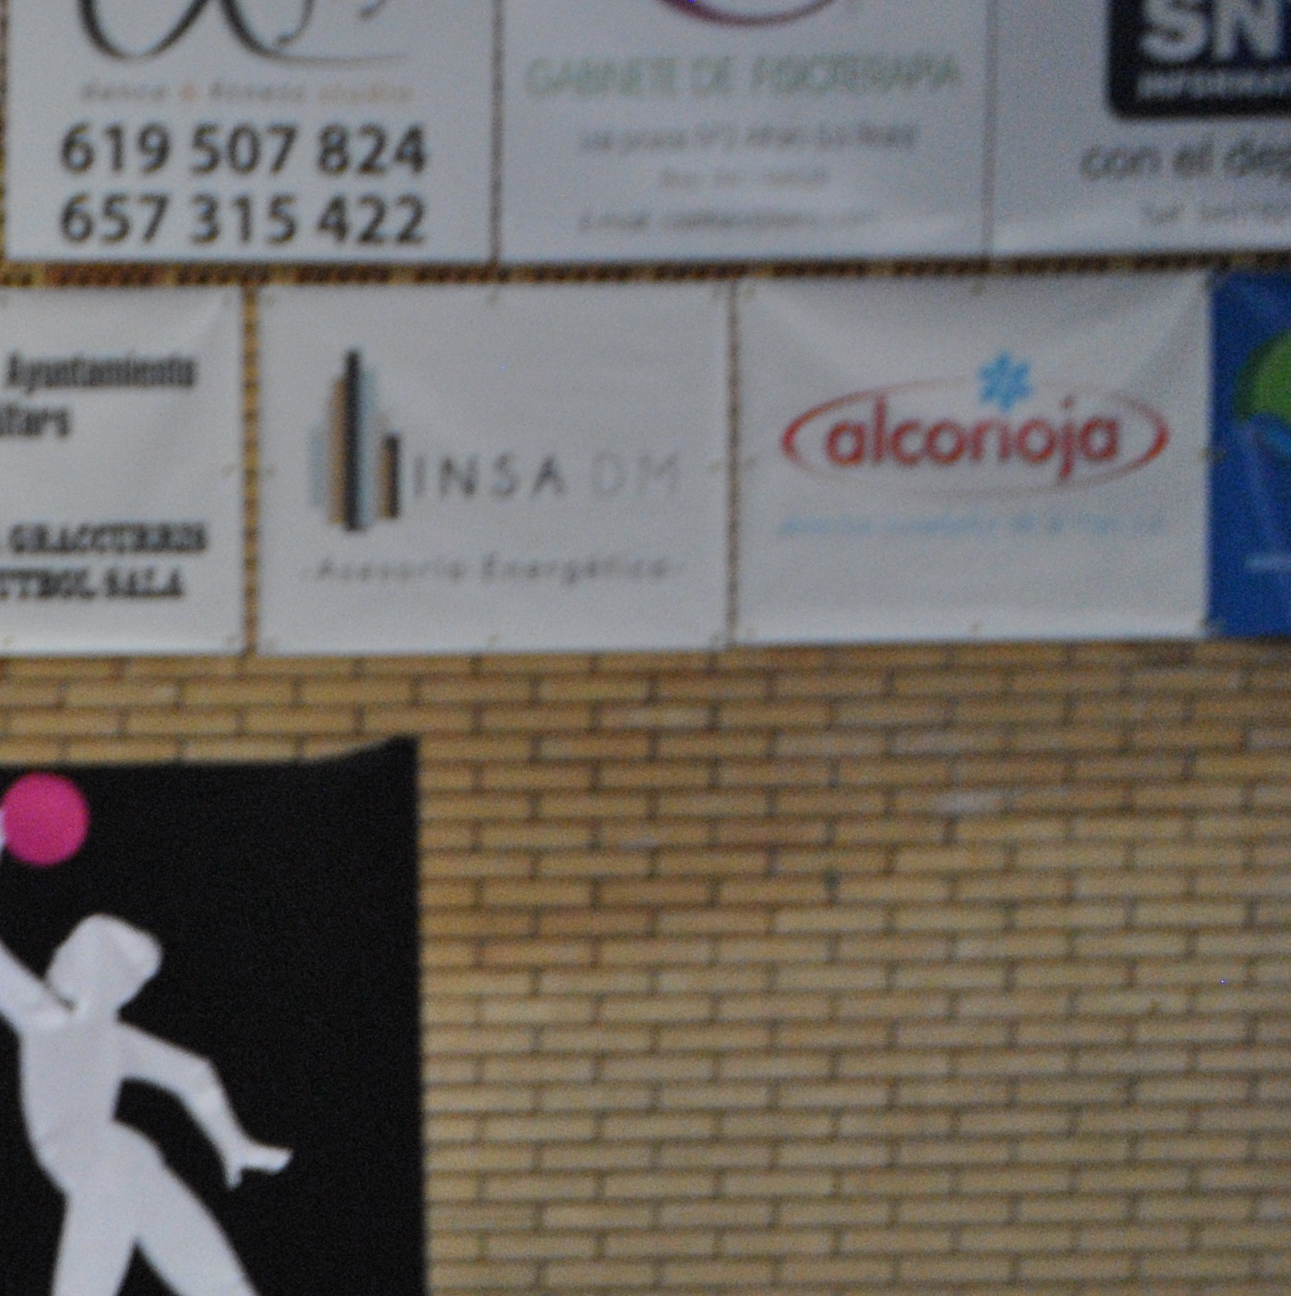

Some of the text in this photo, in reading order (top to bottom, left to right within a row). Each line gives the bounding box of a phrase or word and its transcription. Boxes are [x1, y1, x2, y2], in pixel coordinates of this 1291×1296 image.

[690, 55, 736, 95] DE
[60, 122, 426, 176] 619 507 824
[1080, 147, 1160, 181] con
[60, 193, 426, 245] 657 315 422
[4, 350, 199, 395] Ayuntamiento
[413, 452, 567, 499] INSA
[104, 566, 185, 599] SALA
